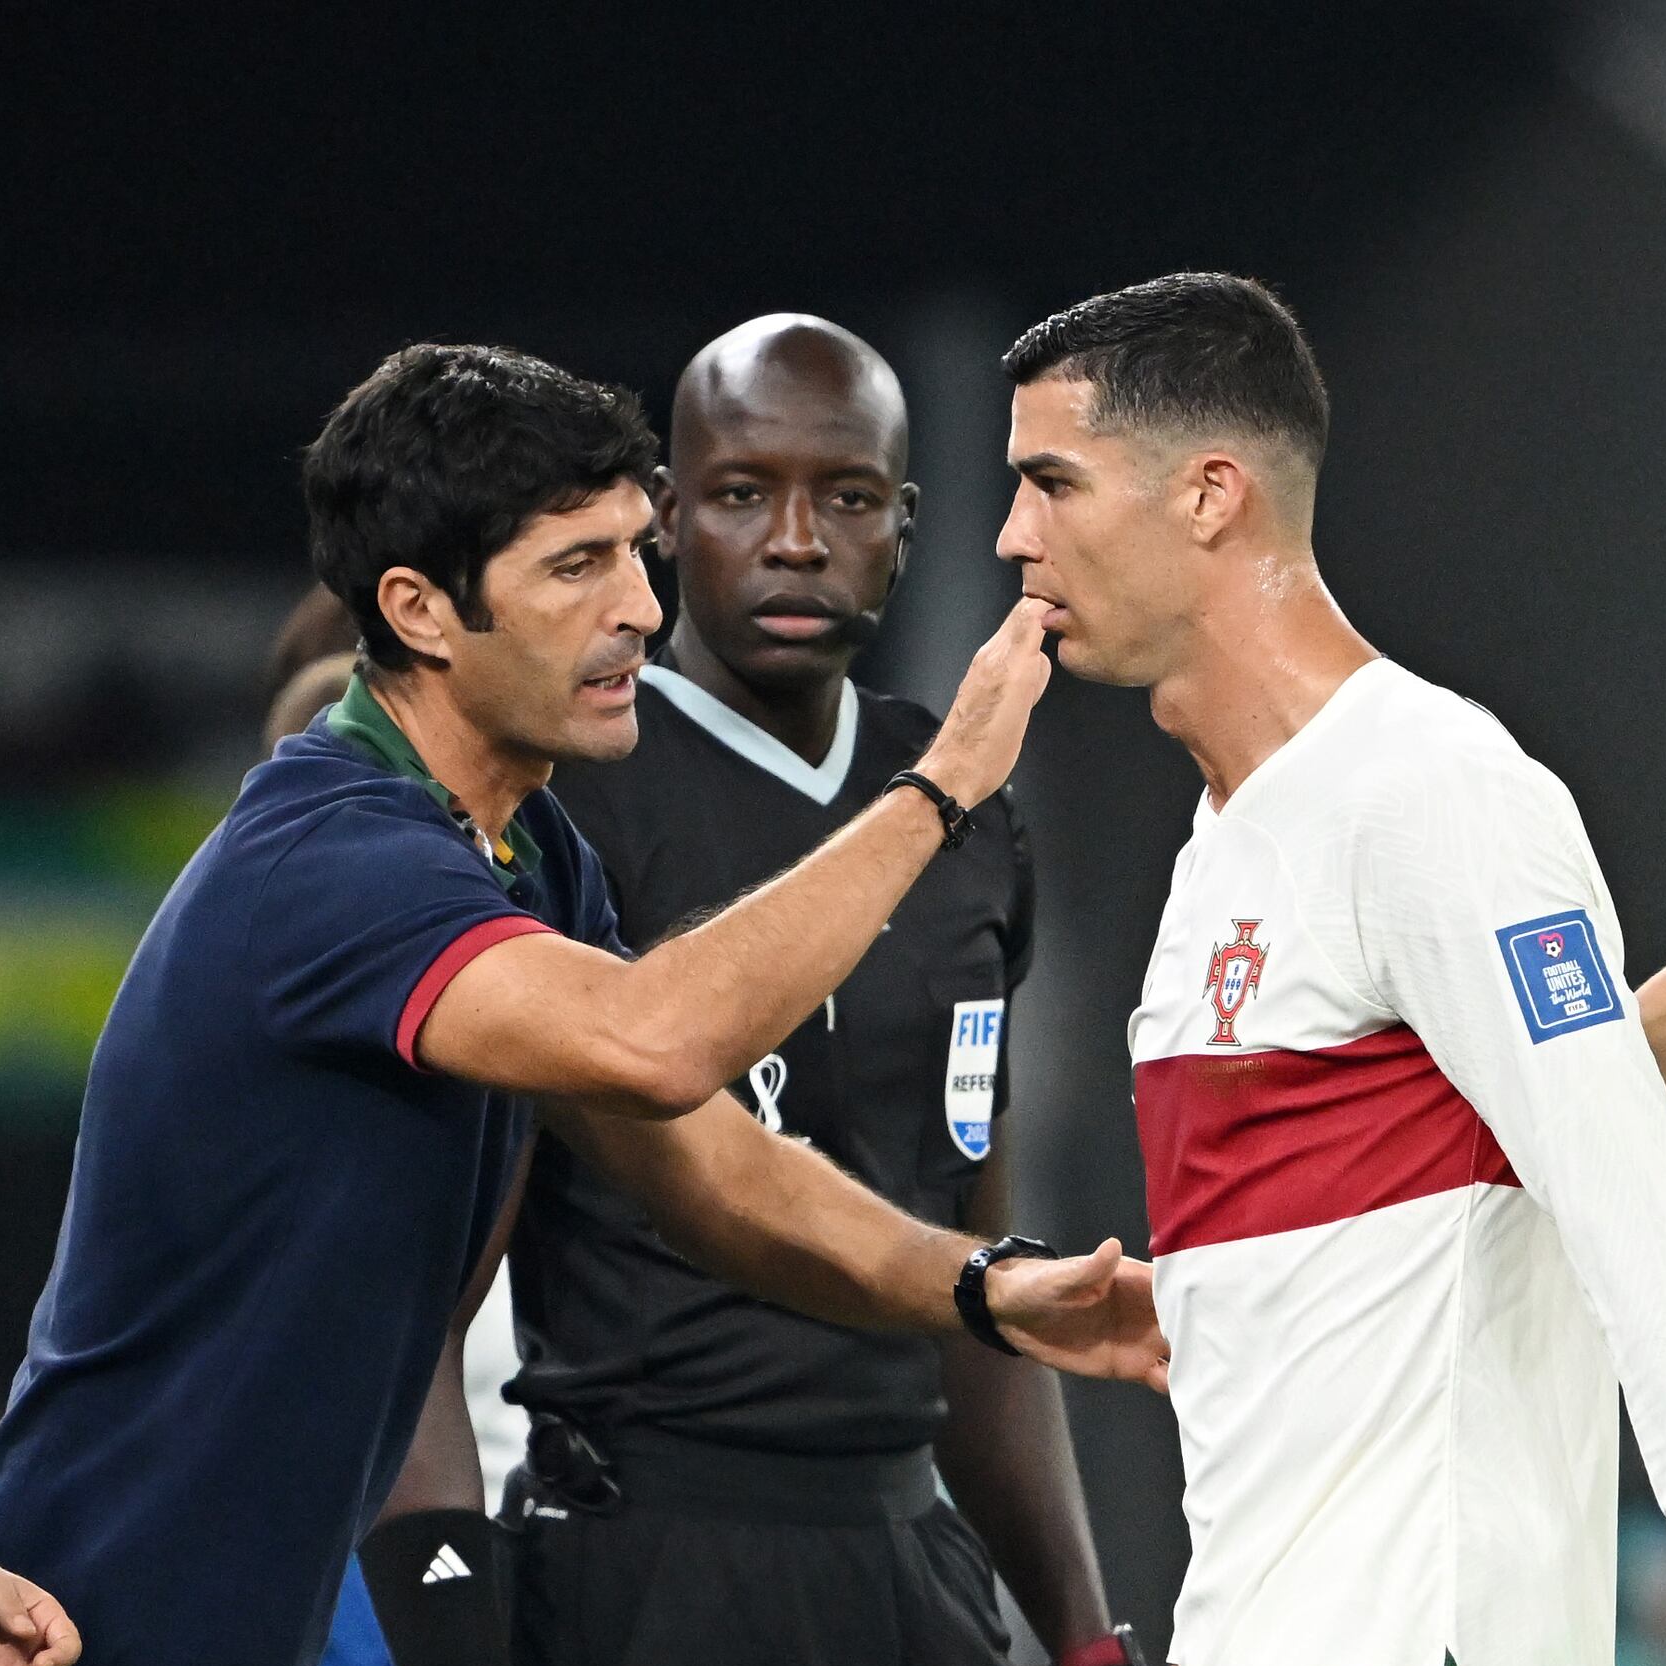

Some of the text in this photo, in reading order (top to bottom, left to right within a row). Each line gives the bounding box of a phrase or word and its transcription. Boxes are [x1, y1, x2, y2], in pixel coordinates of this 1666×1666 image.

[1542, 959, 1581, 978] FOOTBALL
[1546, 970, 1587, 992] UNITES
[1549, 983, 1593, 1005] the World
[1567, 1002, 1584, 1013] FIFA
